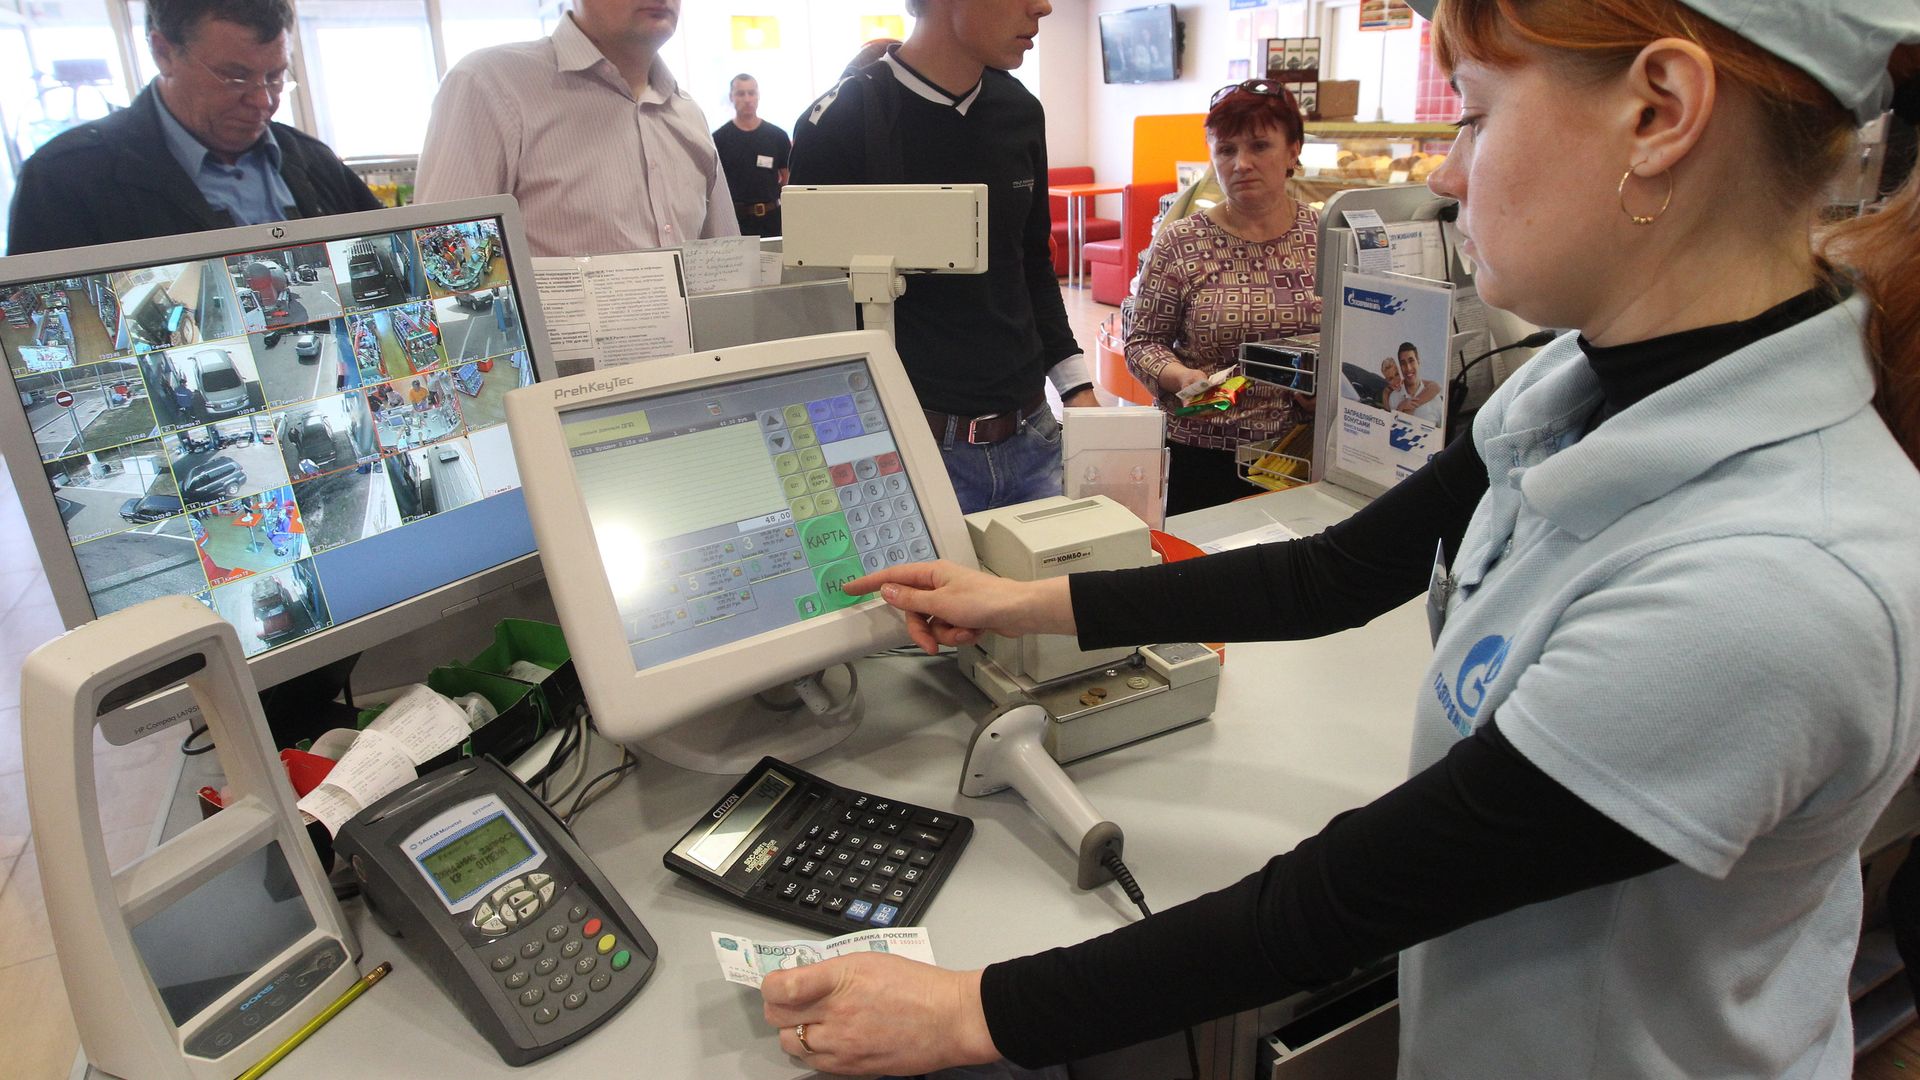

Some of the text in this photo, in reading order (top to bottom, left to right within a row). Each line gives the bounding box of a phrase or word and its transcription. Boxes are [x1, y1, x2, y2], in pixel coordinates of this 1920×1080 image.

[554, 376, 634, 400] PrehKeyTec
[846, 479, 900, 502] 7 8 9
[765, 512, 791, 524] 48,00
[855, 500, 908, 523] 4 5 6
[806, 529, 848, 549] КАРТА
[863, 522, 916, 546] 1 2 3
[742, 536, 754, 551] 3
[870, 549, 905, 568] 0 00
[1057, 552, 1082, 563] КОМБО
[688, 576, 700, 592] 5
[135, 727, 145, 735] HP
[146, 715, 177, 730] Compaq
[712, 793, 740, 819] CITIZEN
[855, 796, 867, 806] MU
[418, 831, 439, 846] SAGEM
[828, 830, 839, 840] M+
[802, 861, 815, 872] MR
[502, 885, 512, 893] OK
[783, 882, 797, 894] MC
[893, 869, 917, 897] 00 0
[482, 907, 491, 915] F1
[551, 926, 560, 935] 3
[526, 943, 573, 952] 2 6
[826, 938, 852, 950] БИЛЕТ
[853, 933, 881, 943] БАНКА
[882, 932, 914, 940] РОССИИ
[753, 943, 797, 957] 1000
[541, 959, 549, 968] 5
[580, 960, 588, 969] 9
[512, 974, 563, 985] 4 8
[525, 991, 578, 1003] 7 0
